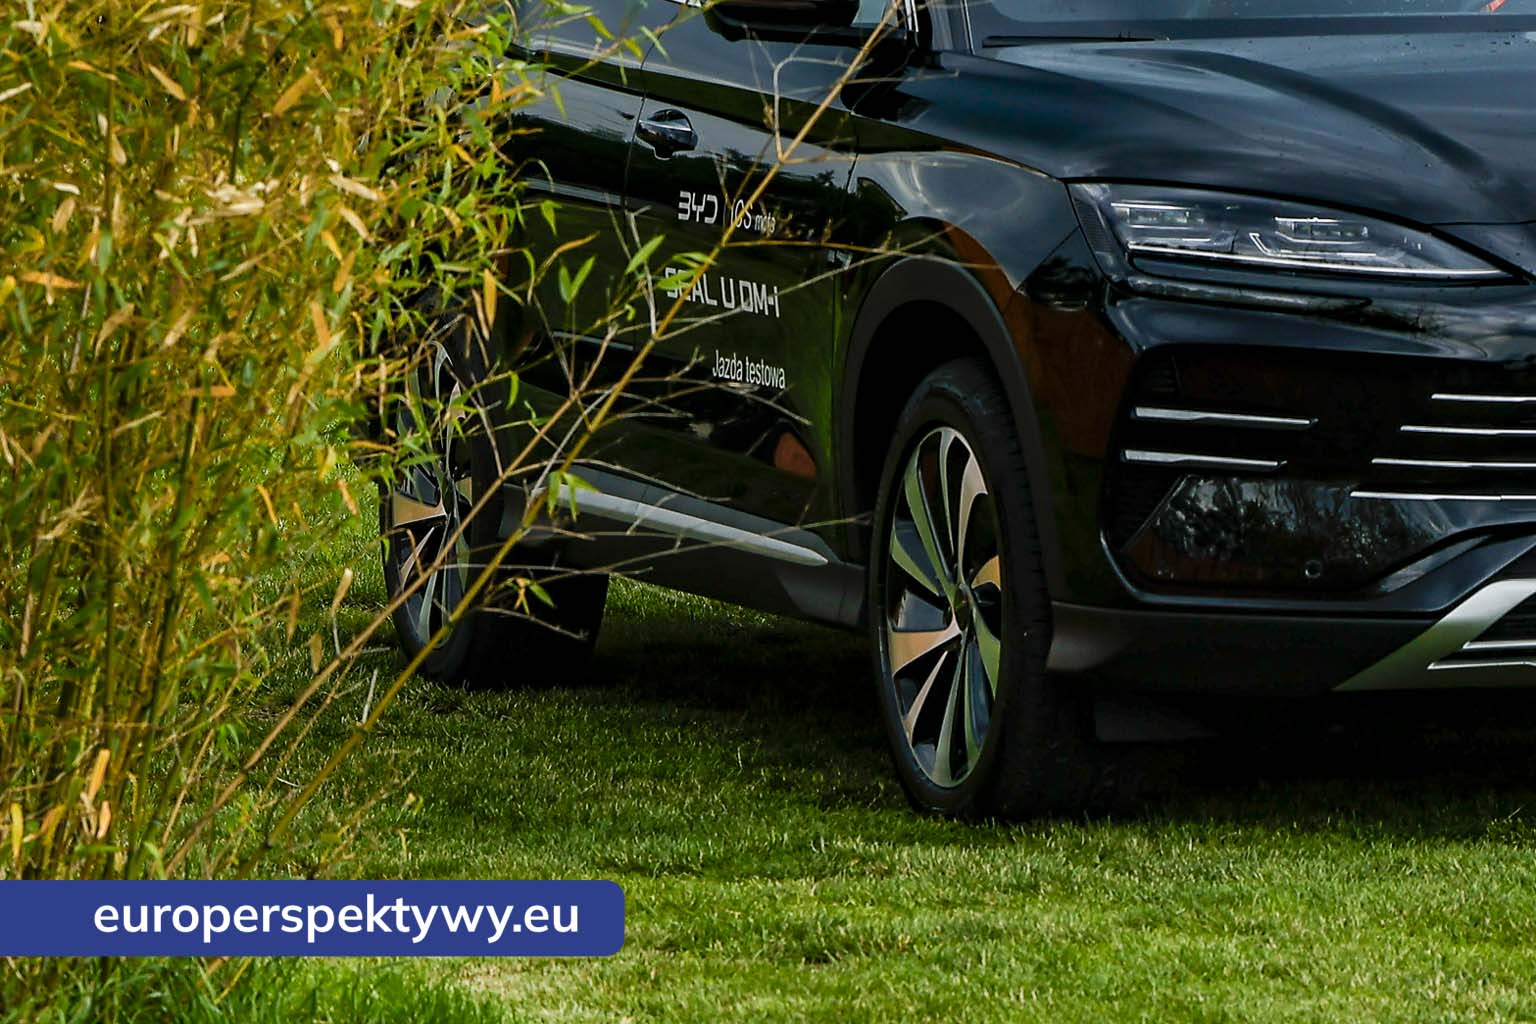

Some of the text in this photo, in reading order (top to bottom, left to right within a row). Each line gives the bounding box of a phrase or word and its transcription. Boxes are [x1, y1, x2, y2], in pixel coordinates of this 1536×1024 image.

[678, 190, 718, 225] BYD
[720, 276, 735, 309] U
[712, 349, 786, 389] Jazda testowa
